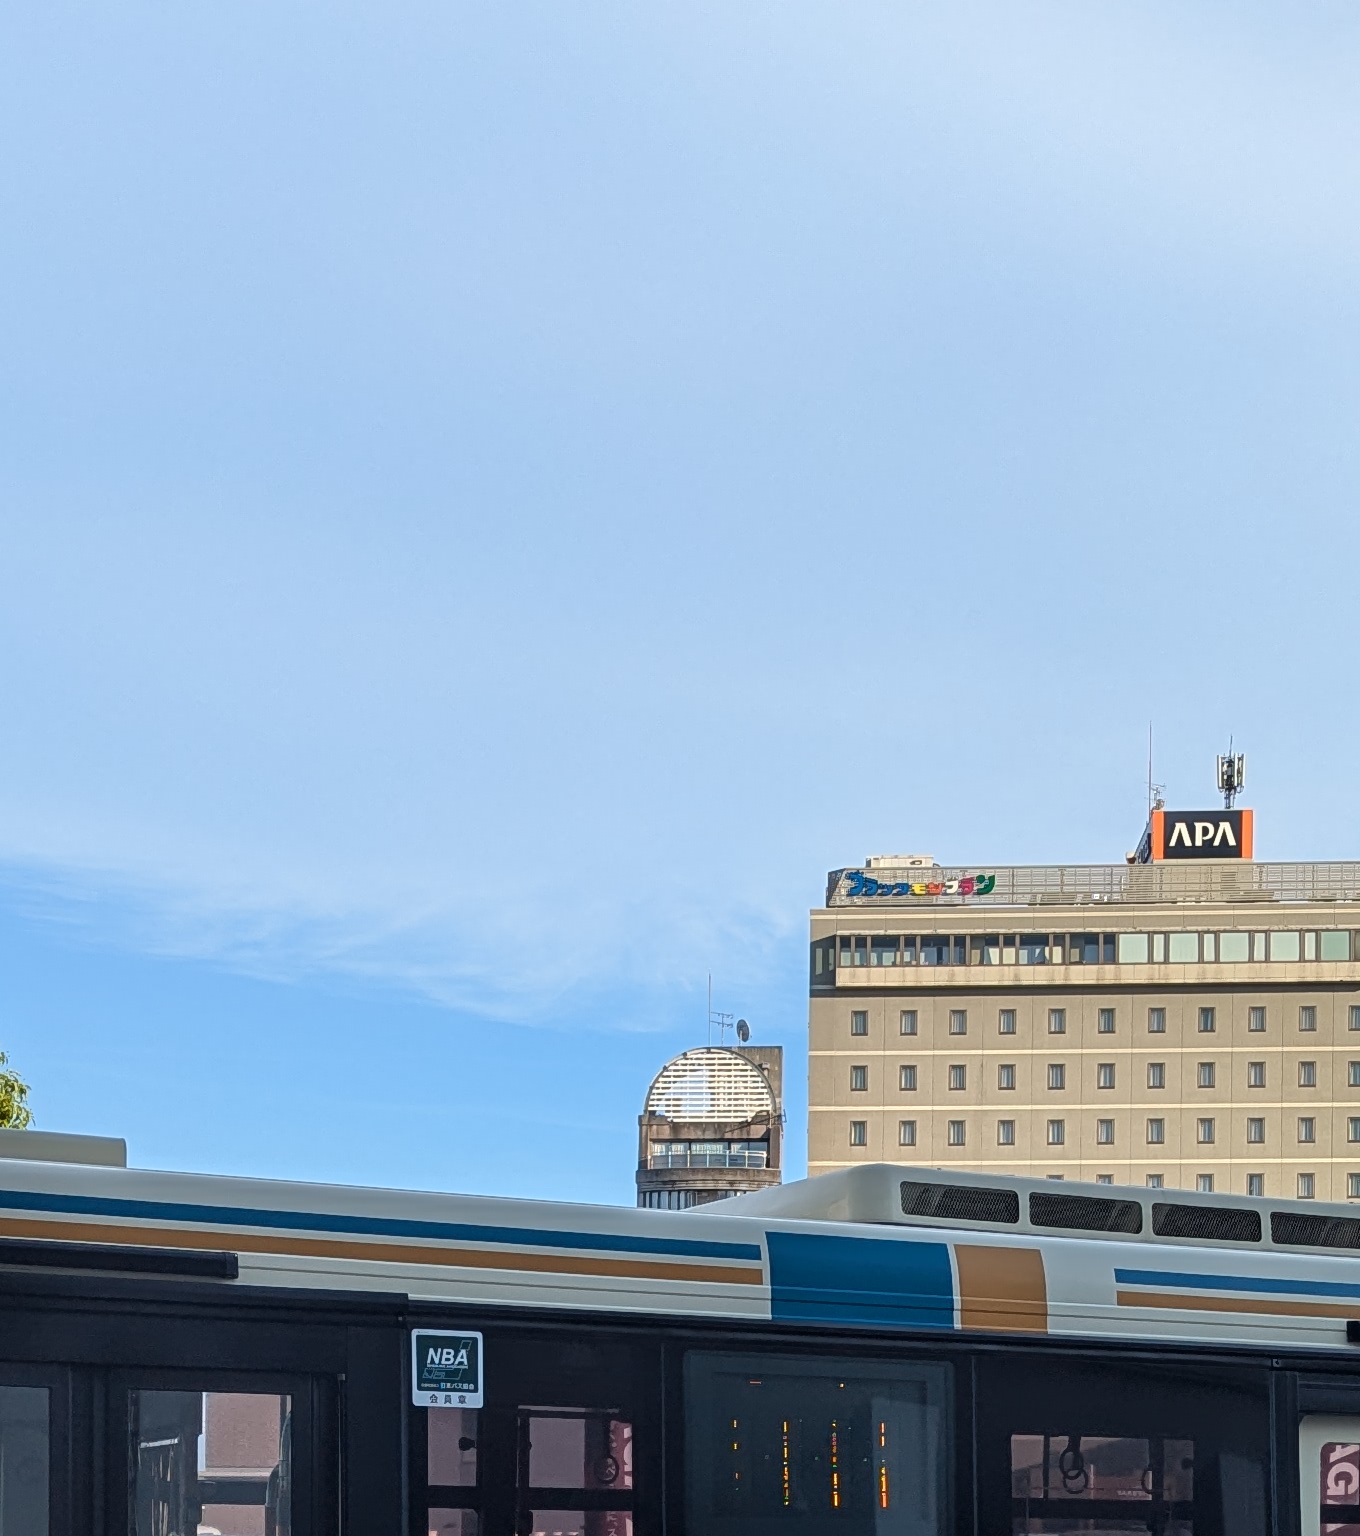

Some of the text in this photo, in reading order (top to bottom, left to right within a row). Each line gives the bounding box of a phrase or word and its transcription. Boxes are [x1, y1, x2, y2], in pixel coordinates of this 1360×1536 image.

[1169, 820, 1237, 848] APA
[846, 870, 996, 897] ブラックモンブラン
[426, 1347, 468, 1366] NBA
